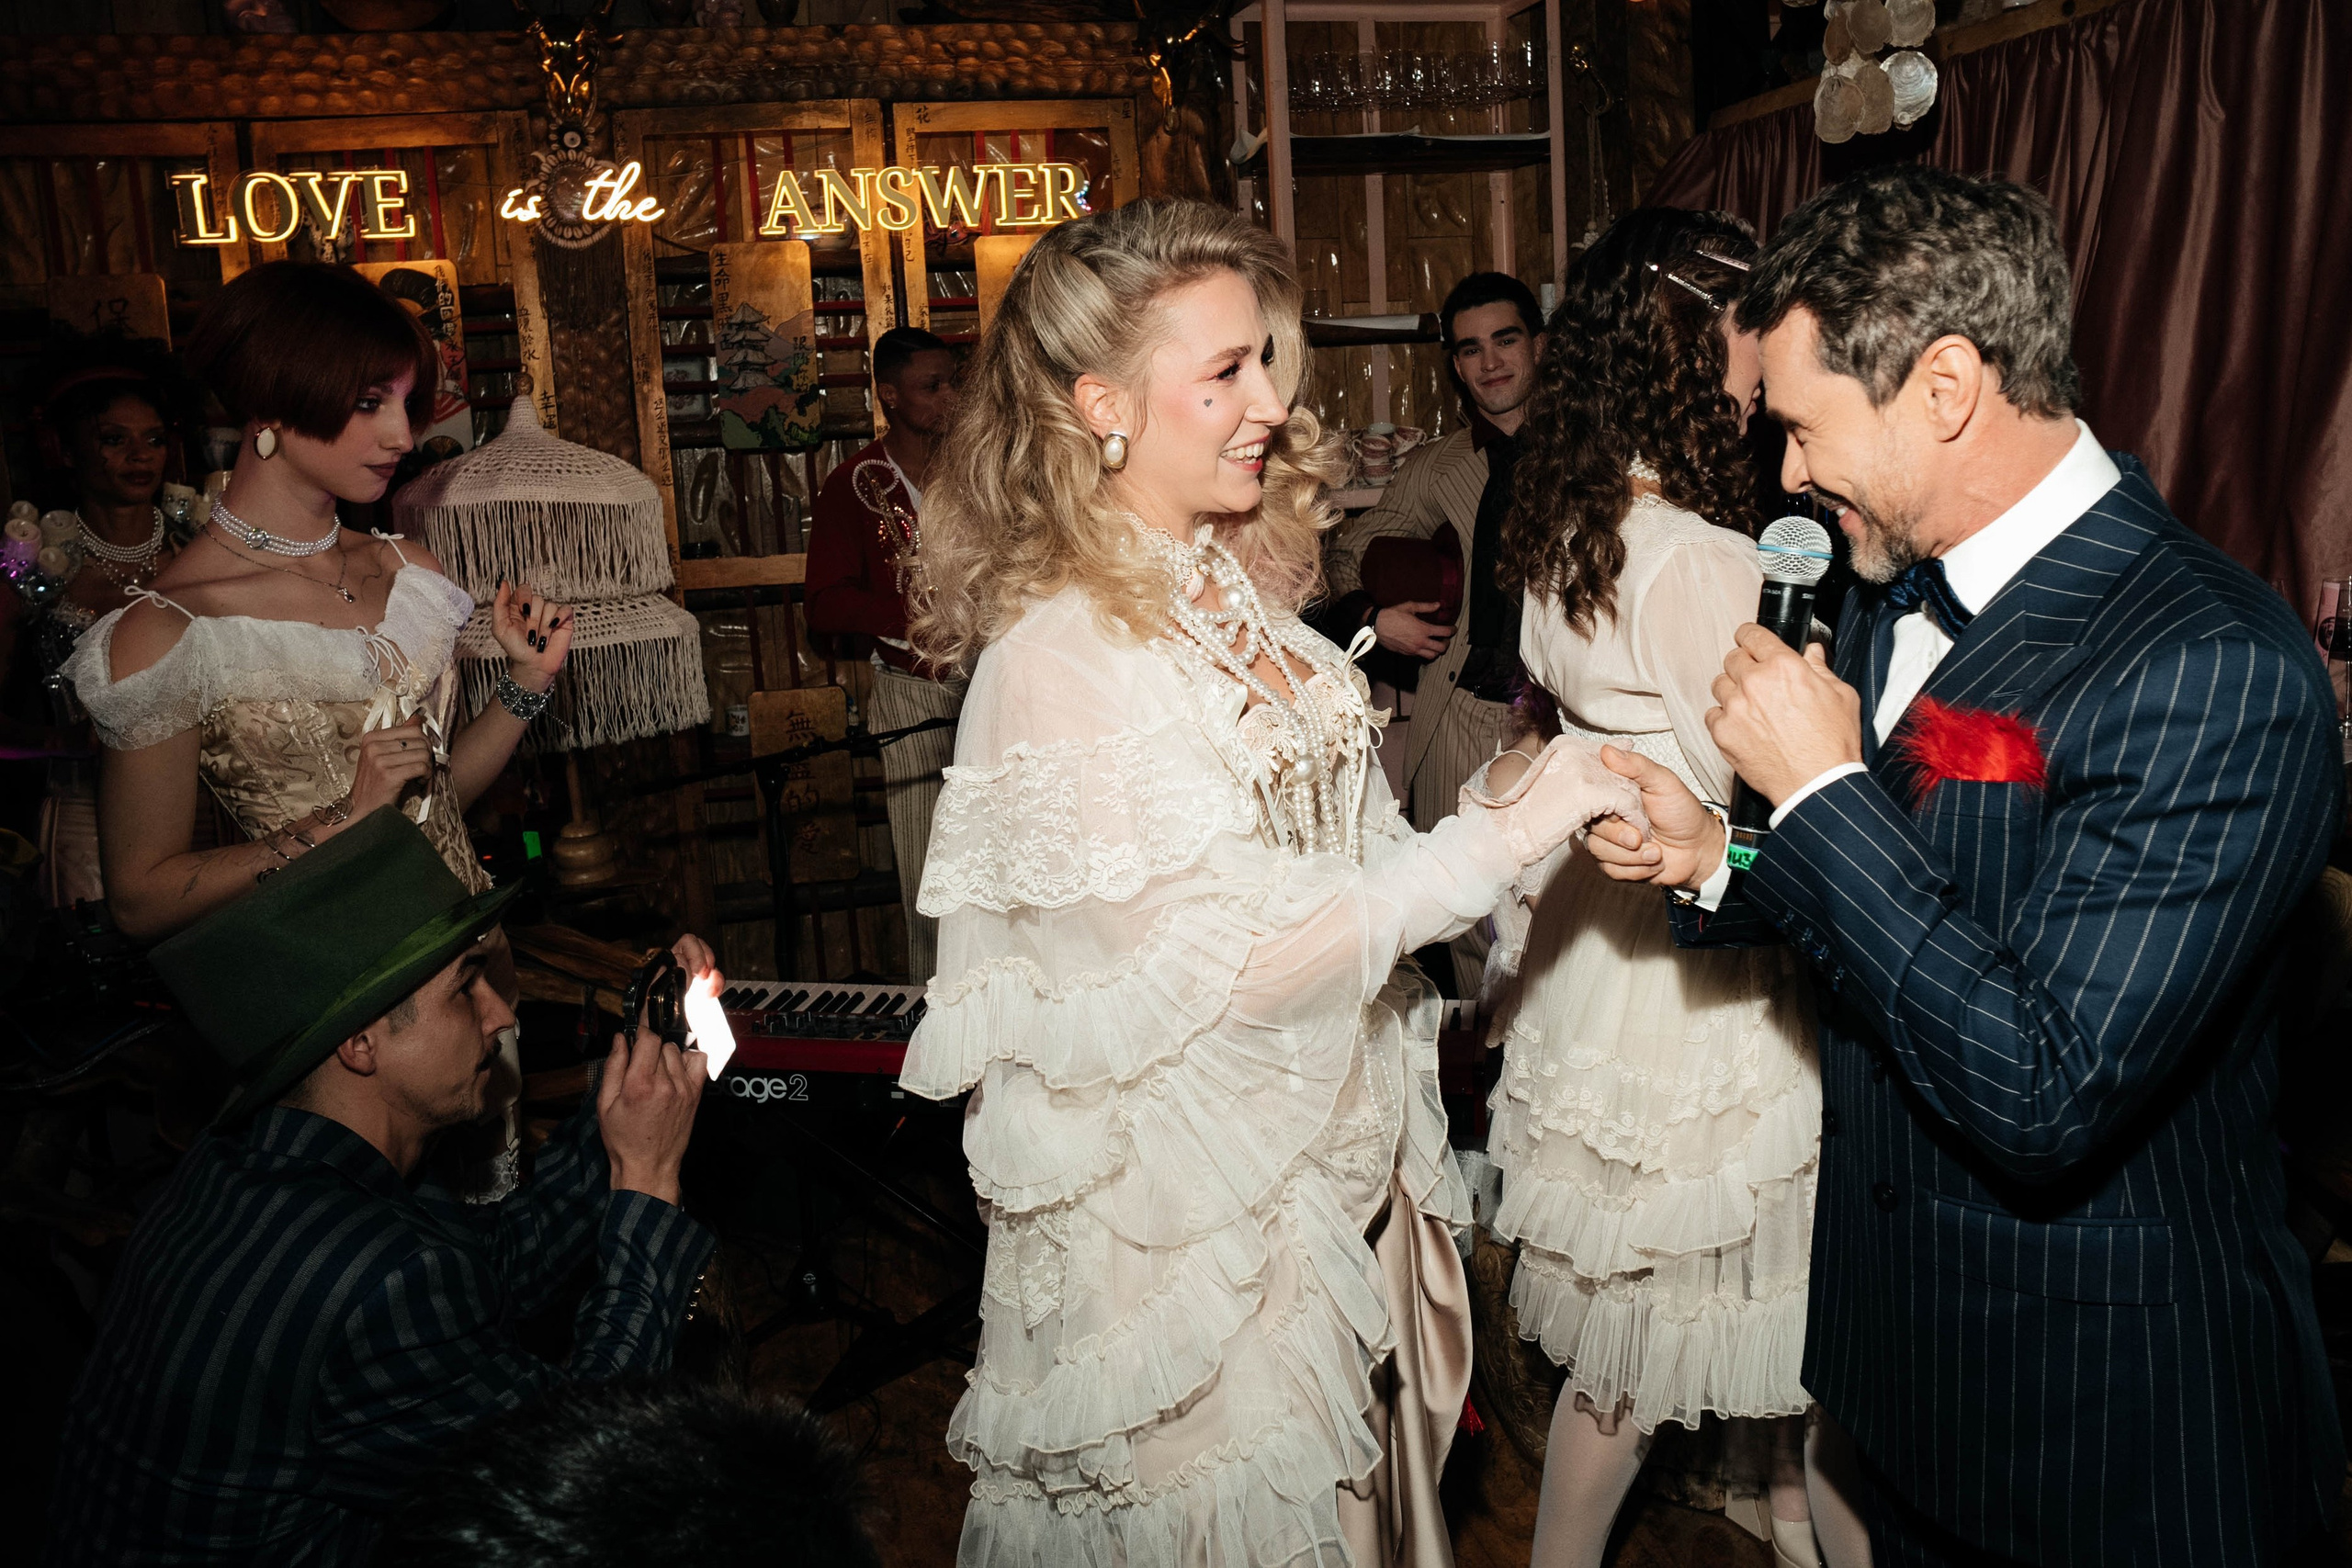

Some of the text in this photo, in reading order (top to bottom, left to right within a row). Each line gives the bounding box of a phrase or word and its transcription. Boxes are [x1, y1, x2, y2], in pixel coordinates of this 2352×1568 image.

[170, 169, 416, 243] LOVE
[501, 188, 542, 222] is
[582, 161, 665, 222] the
[760, 163, 1088, 234] ANSWER
